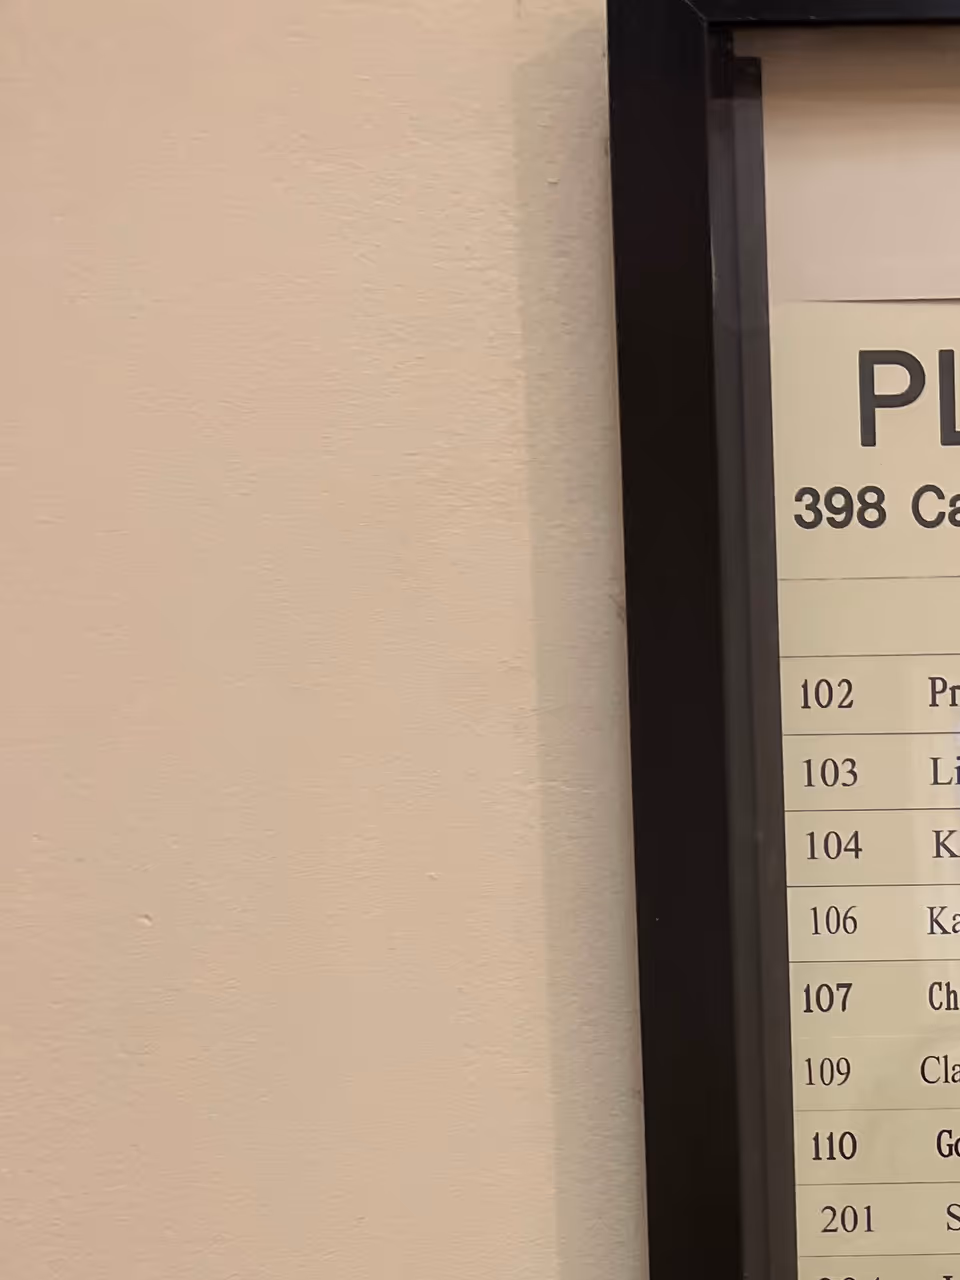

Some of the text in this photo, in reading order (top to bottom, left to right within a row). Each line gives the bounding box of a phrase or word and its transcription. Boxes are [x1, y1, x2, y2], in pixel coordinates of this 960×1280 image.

[793, 485, 887, 530] 398
[800, 678, 854, 710] 102
[803, 757, 858, 788] 103
[806, 830, 863, 860] 104
[810, 905, 858, 936] 106
[803, 982, 853, 1014] 107
[804, 1057, 851, 1087] 109
[811, 1131, 858, 1161] 110
[820, 1205, 874, 1233] 201
